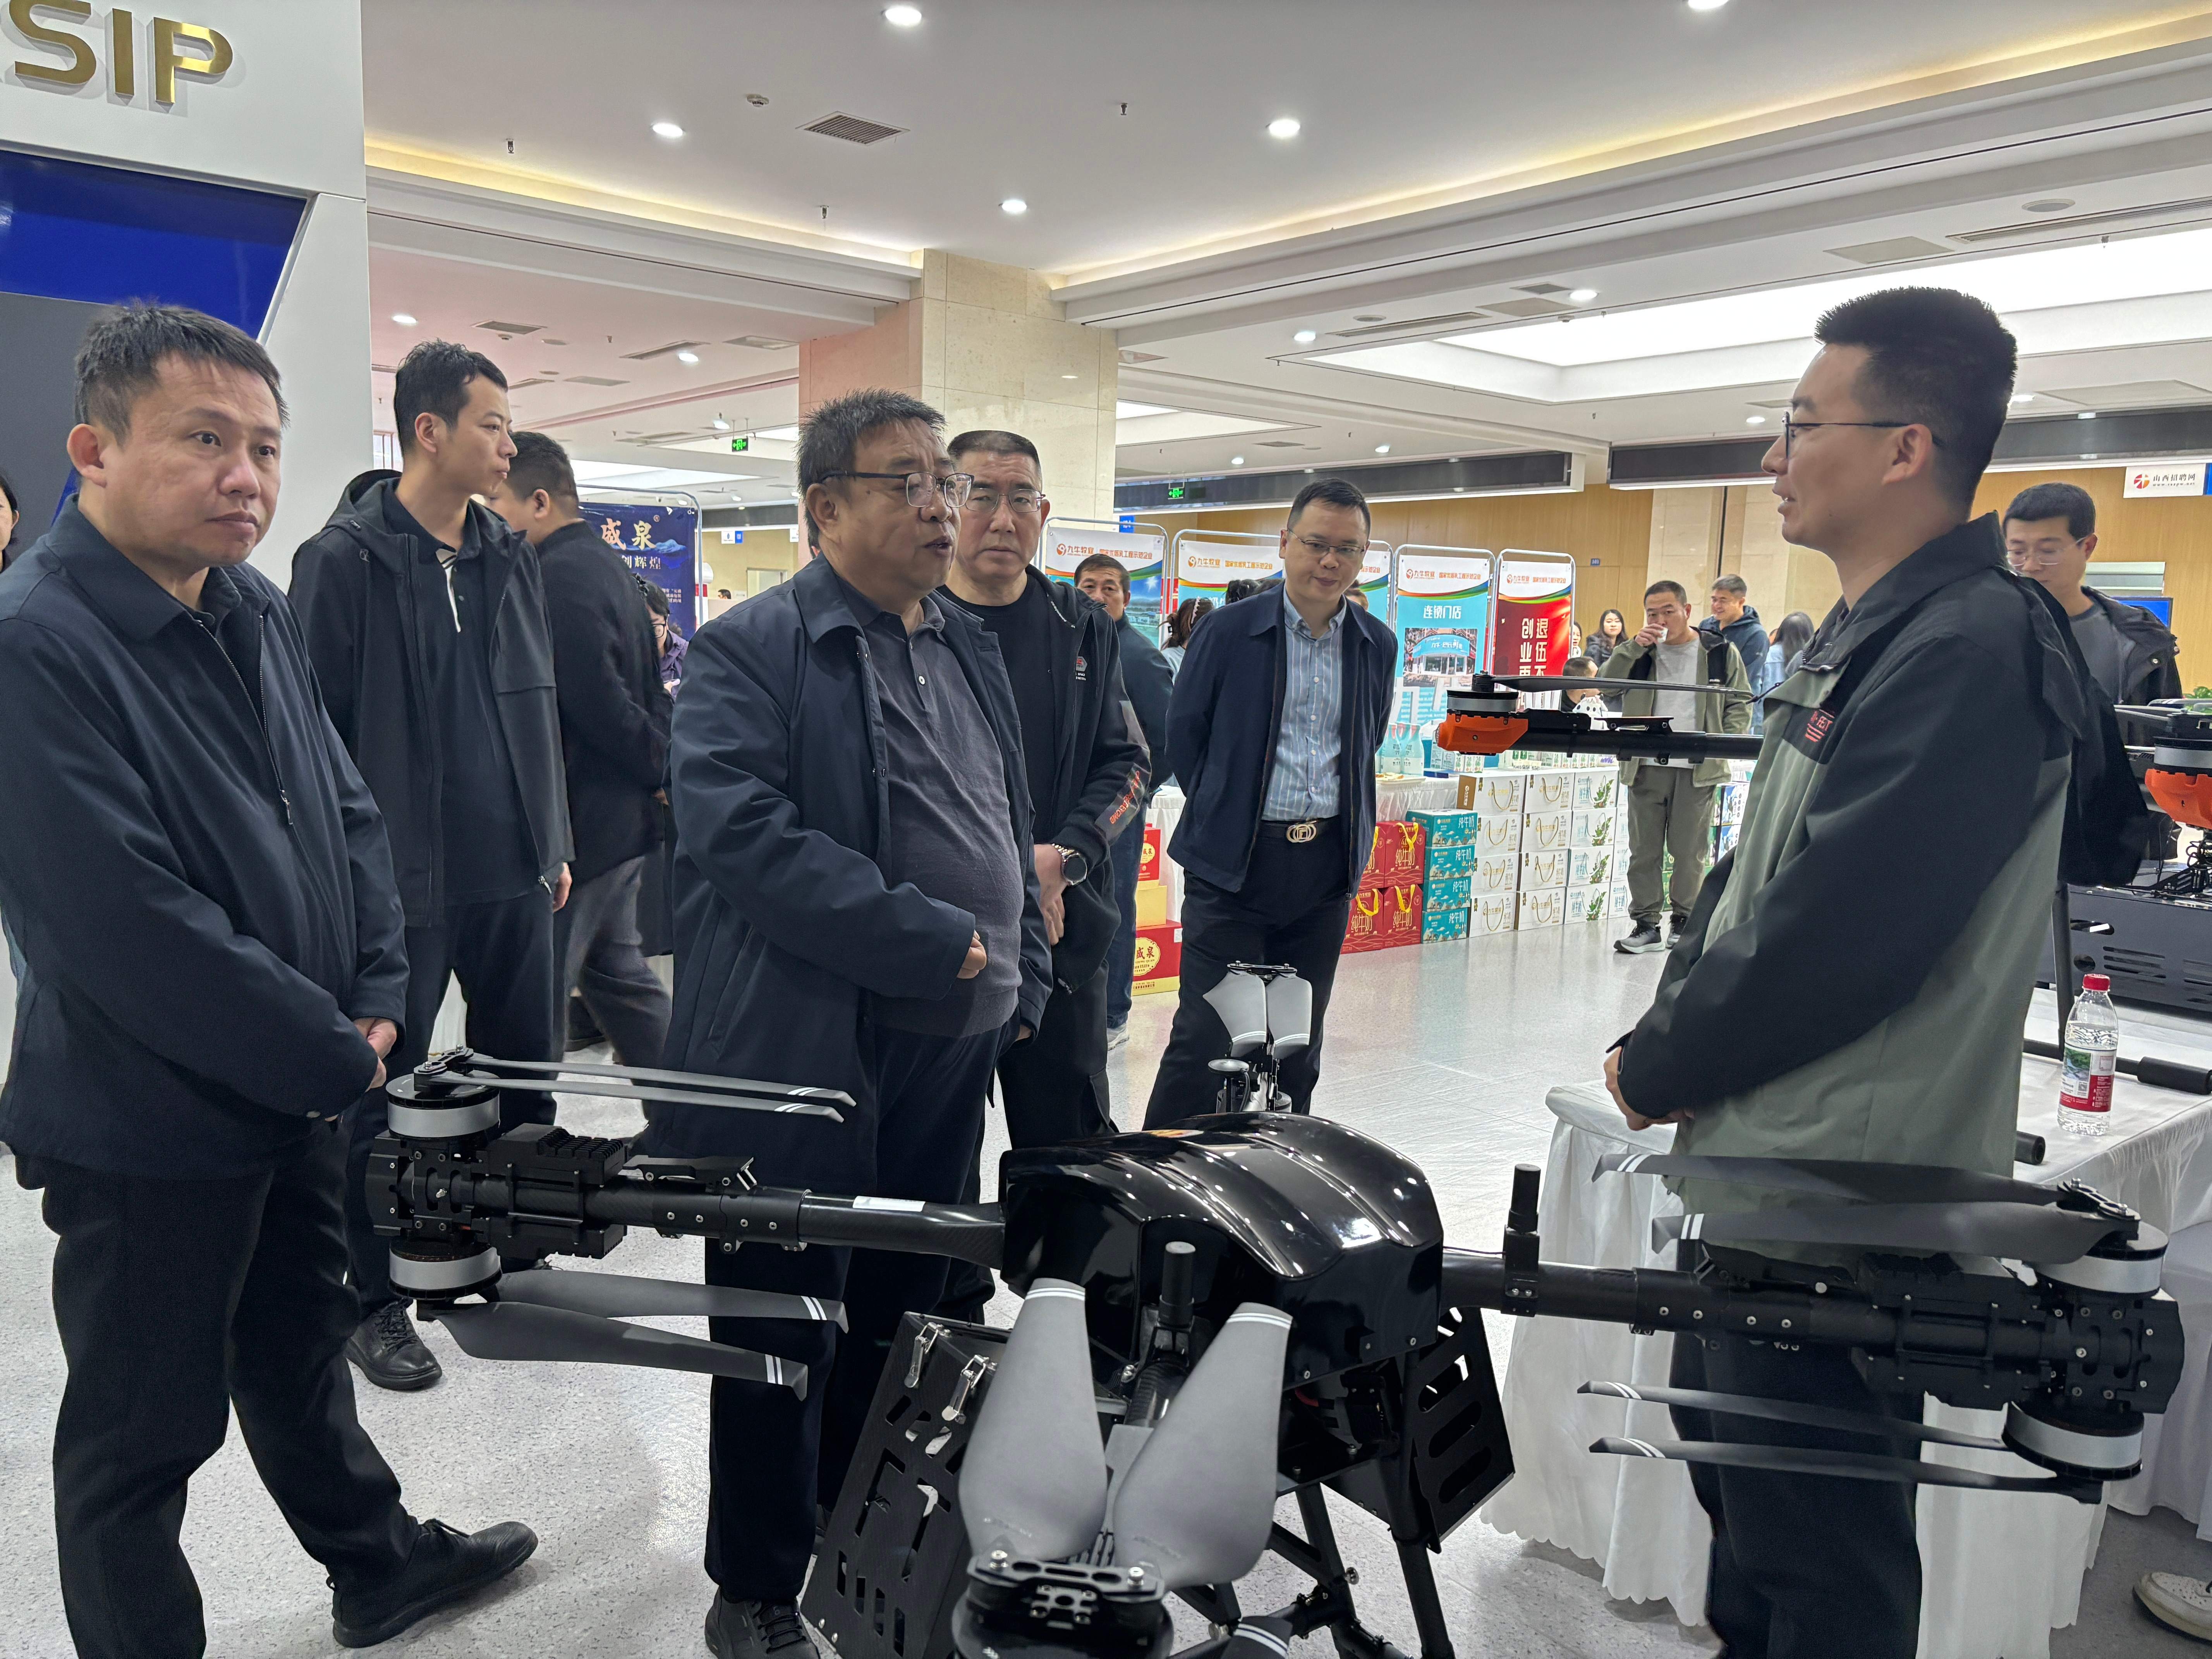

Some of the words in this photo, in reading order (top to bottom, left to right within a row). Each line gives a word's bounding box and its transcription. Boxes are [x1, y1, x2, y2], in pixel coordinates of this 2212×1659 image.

[1067, 545, 1094, 554] 九牛牧业
[1423, 605, 1462, 619] 连锁门店
[1458, 816, 1474, 828] 纯牛奶
[1395, 848, 1415, 867] 纯牛奶
[1456, 848, 1471, 861] 纯牛奶
[1453, 879, 1468, 892] 纯牛奶
[1351, 914, 1372, 933] 纯牛奶
[1393, 908, 1412, 928] 纯牛奶
[1449, 910, 1465, 924] 纯牛奶
